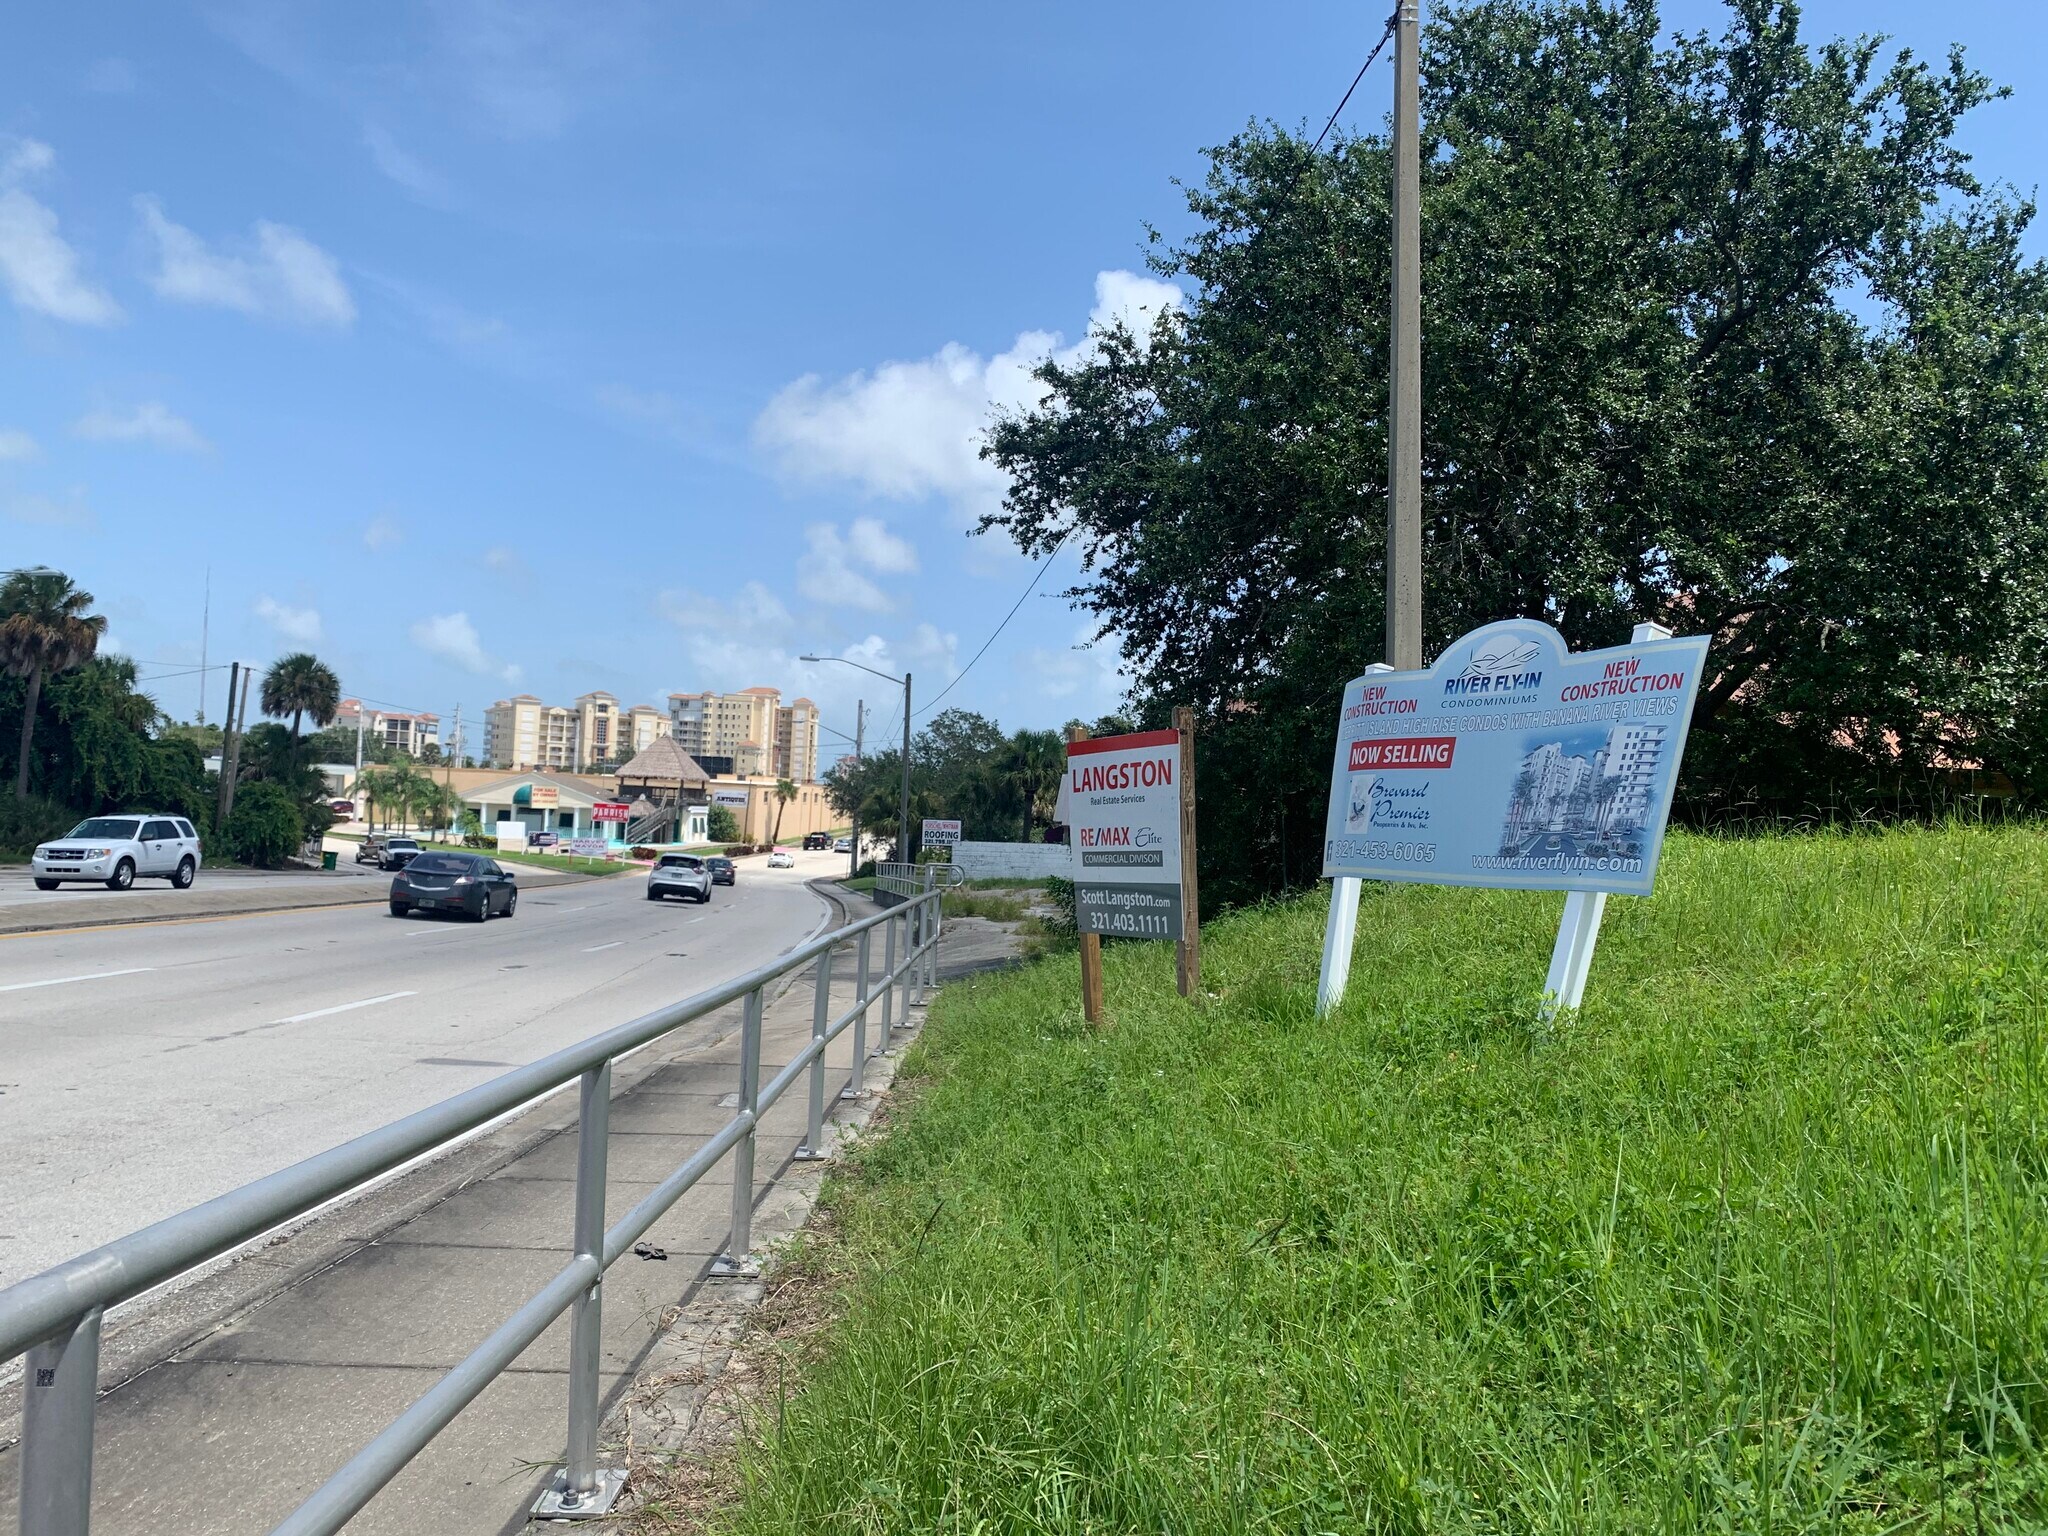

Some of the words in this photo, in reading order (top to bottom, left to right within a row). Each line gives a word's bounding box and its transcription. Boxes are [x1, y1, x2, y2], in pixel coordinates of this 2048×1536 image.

[1603, 659, 1641, 679] NEW
[1362, 686, 1387, 702] NEW
[1443, 676, 1491, 695] RIVER
[1493, 671, 1542, 692] FLY-IN
[1561, 672, 1684, 702] CONSTRUCTION
[1344, 699, 1418, 721] CONSTRUCTION
[1440, 694, 1538, 709] CONDOMINIUMS
[1366, 718, 1401, 737] ISLAND
[1401, 716, 1430, 735] HIGH
[1430, 714, 1458, 734] RISE
[1460, 713, 1509, 733] CONDOS
[1510, 711, 1541, 731] WITH
[1541, 704, 1590, 728] BANANA
[1591, 699, 1630, 721] RIVER
[1632, 695, 1678, 718] VIEWS
[1351, 746, 1382, 766] NOW
[1383, 743, 1450, 763] SELLING
[1072, 758, 1172, 794] LANGSTON
[1368, 777, 1430, 798] Brevard
[1090, 797, 1102, 806] Real
[1102, 796, 1120, 805] Estate
[1120, 794, 1146, 804] Services
[1370, 799, 1431, 822] Premier
[593, 808, 629, 819] PARRISH
[924, 830, 959, 840] ROOFING
[1080, 826, 1130, 847] RE/MAX
[1134, 826, 1163, 848] Elite
[1084, 854, 1129, 864] COMMERCIAL
[1335, 840, 1437, 862] 321-453-6065
[1472, 852, 1643, 875] www.riverflyin.com
[1081, 889, 1105, 906] Scott
[1105, 891, 1171, 910] Langston.com
[1090, 911, 1169, 934] 321.403.1111
